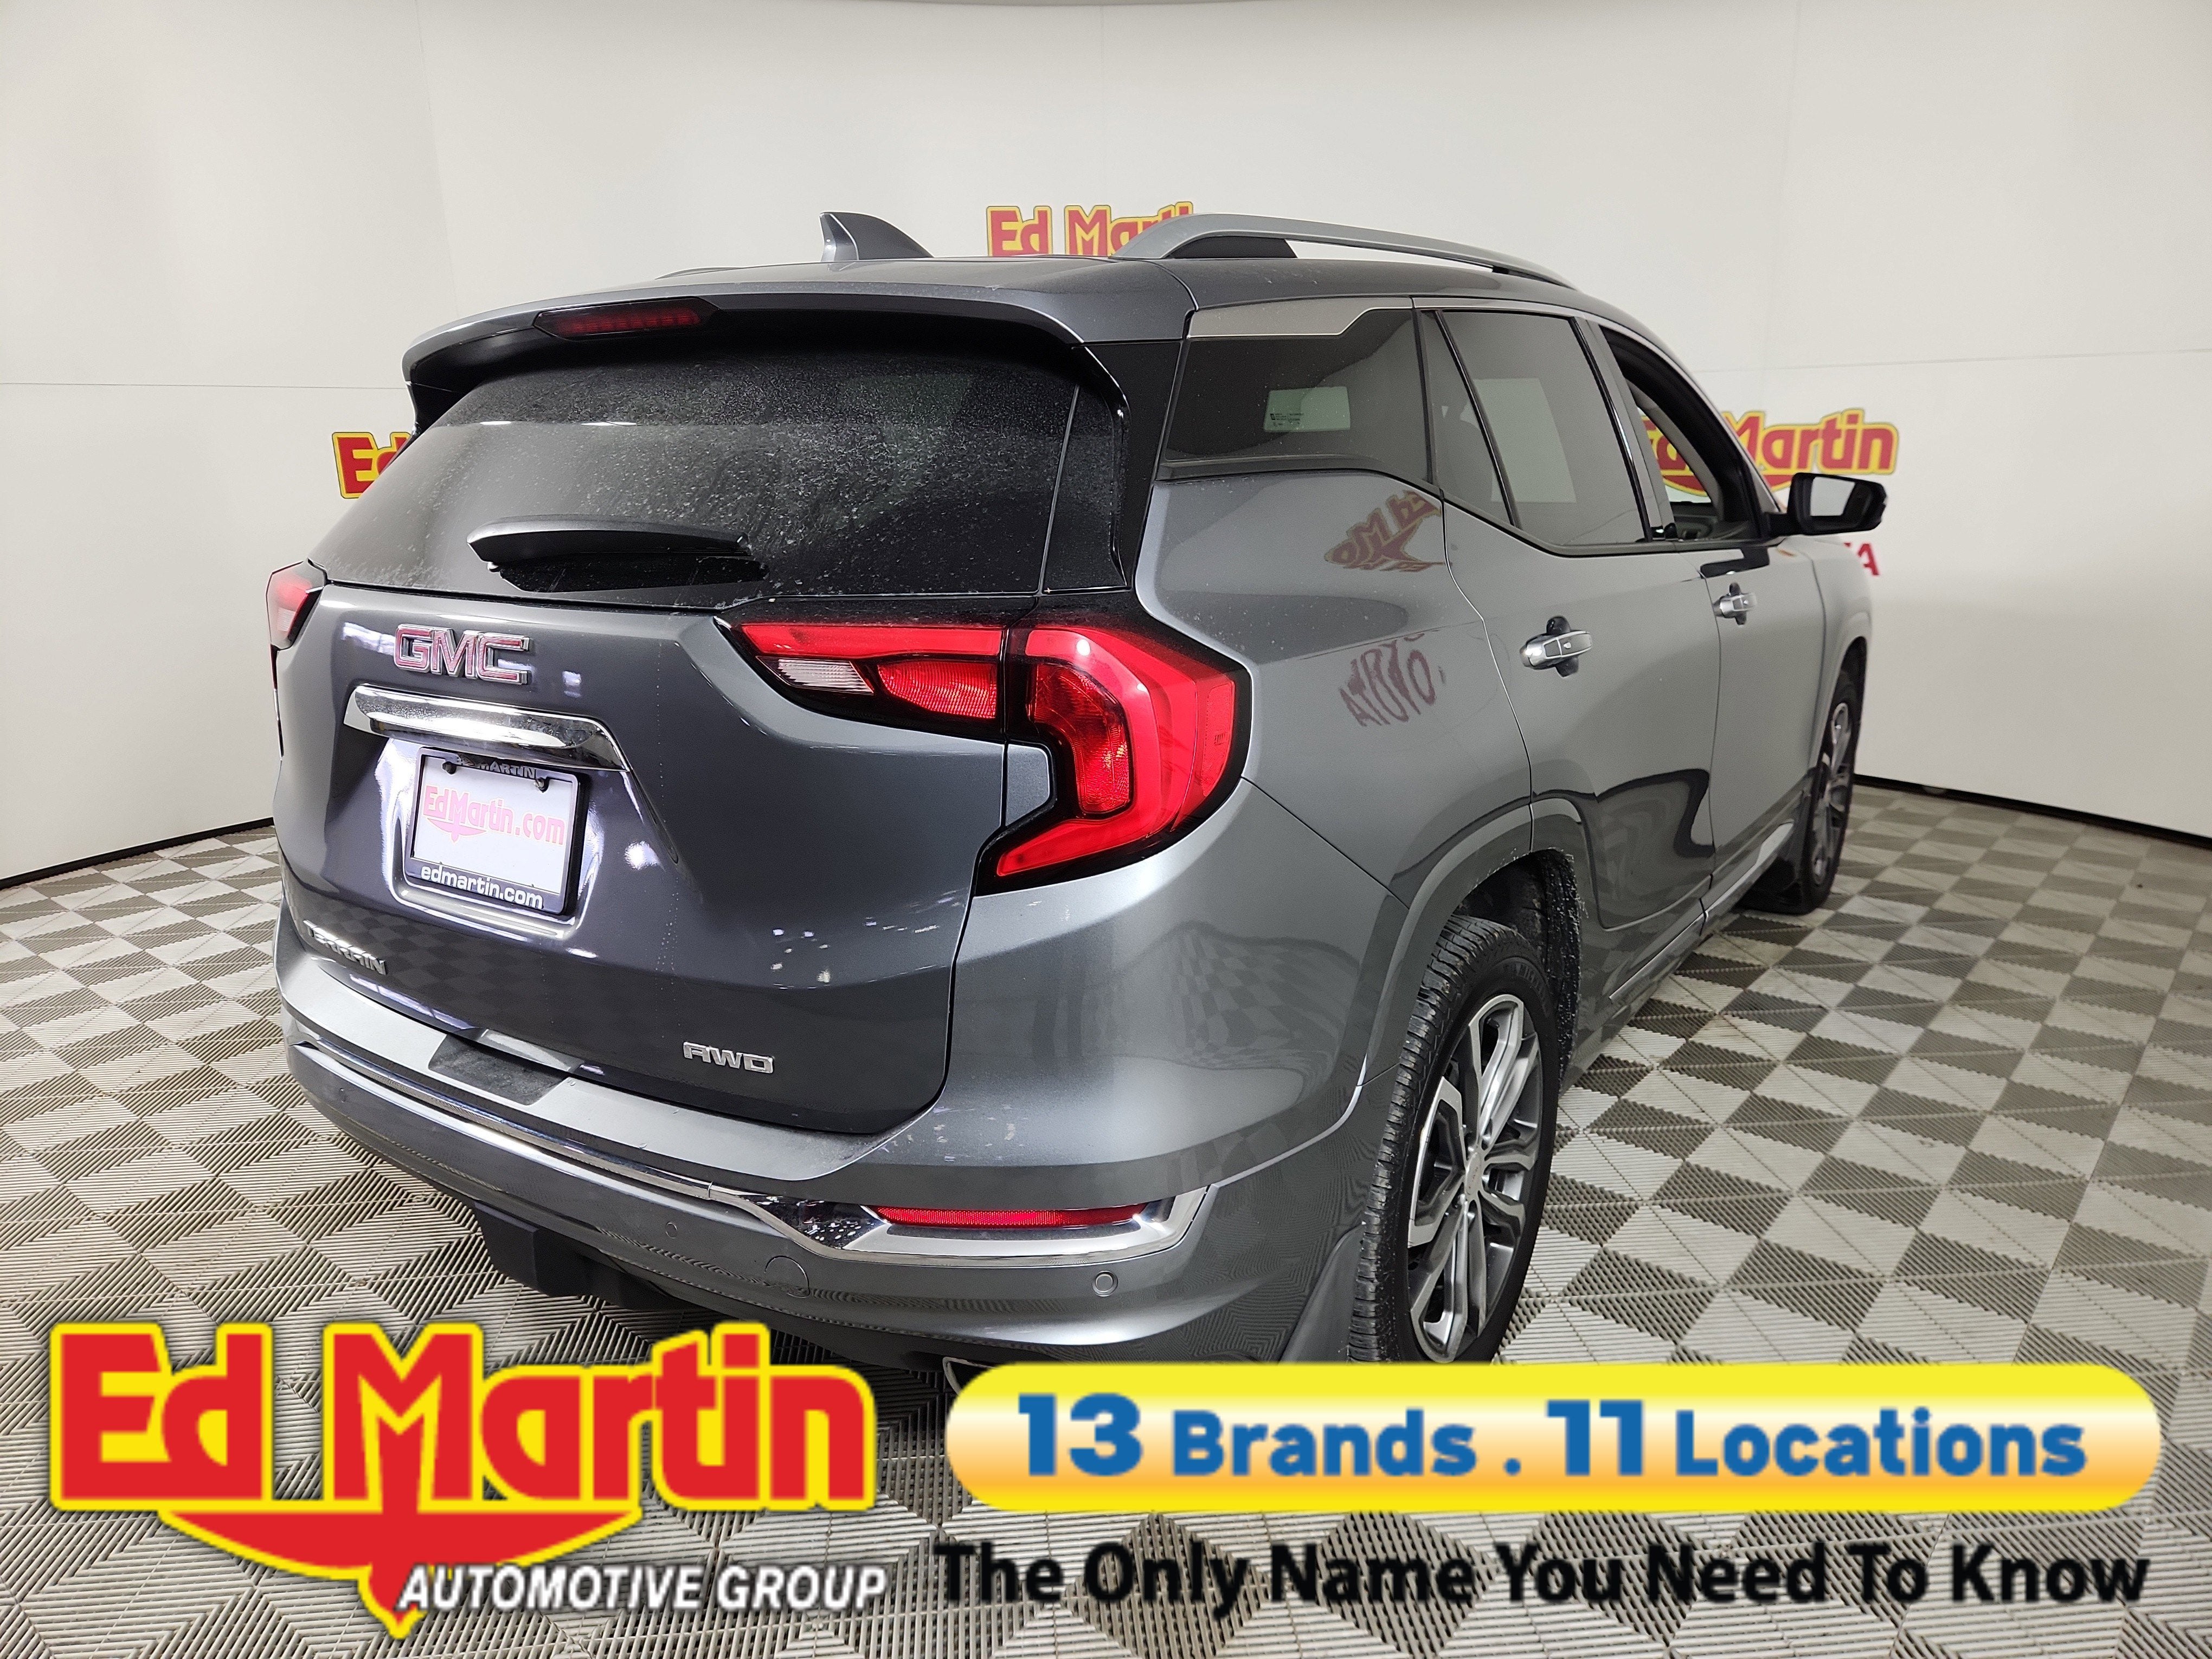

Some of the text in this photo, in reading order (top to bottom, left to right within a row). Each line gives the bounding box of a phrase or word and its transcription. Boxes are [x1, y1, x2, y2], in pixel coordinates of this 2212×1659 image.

[987, 206, 1052, 256] Ed
[394, 623, 531, 685] GMC
[420, 865, 544, 909] edmartin.com
[683, 1041, 774, 1074] AWD
